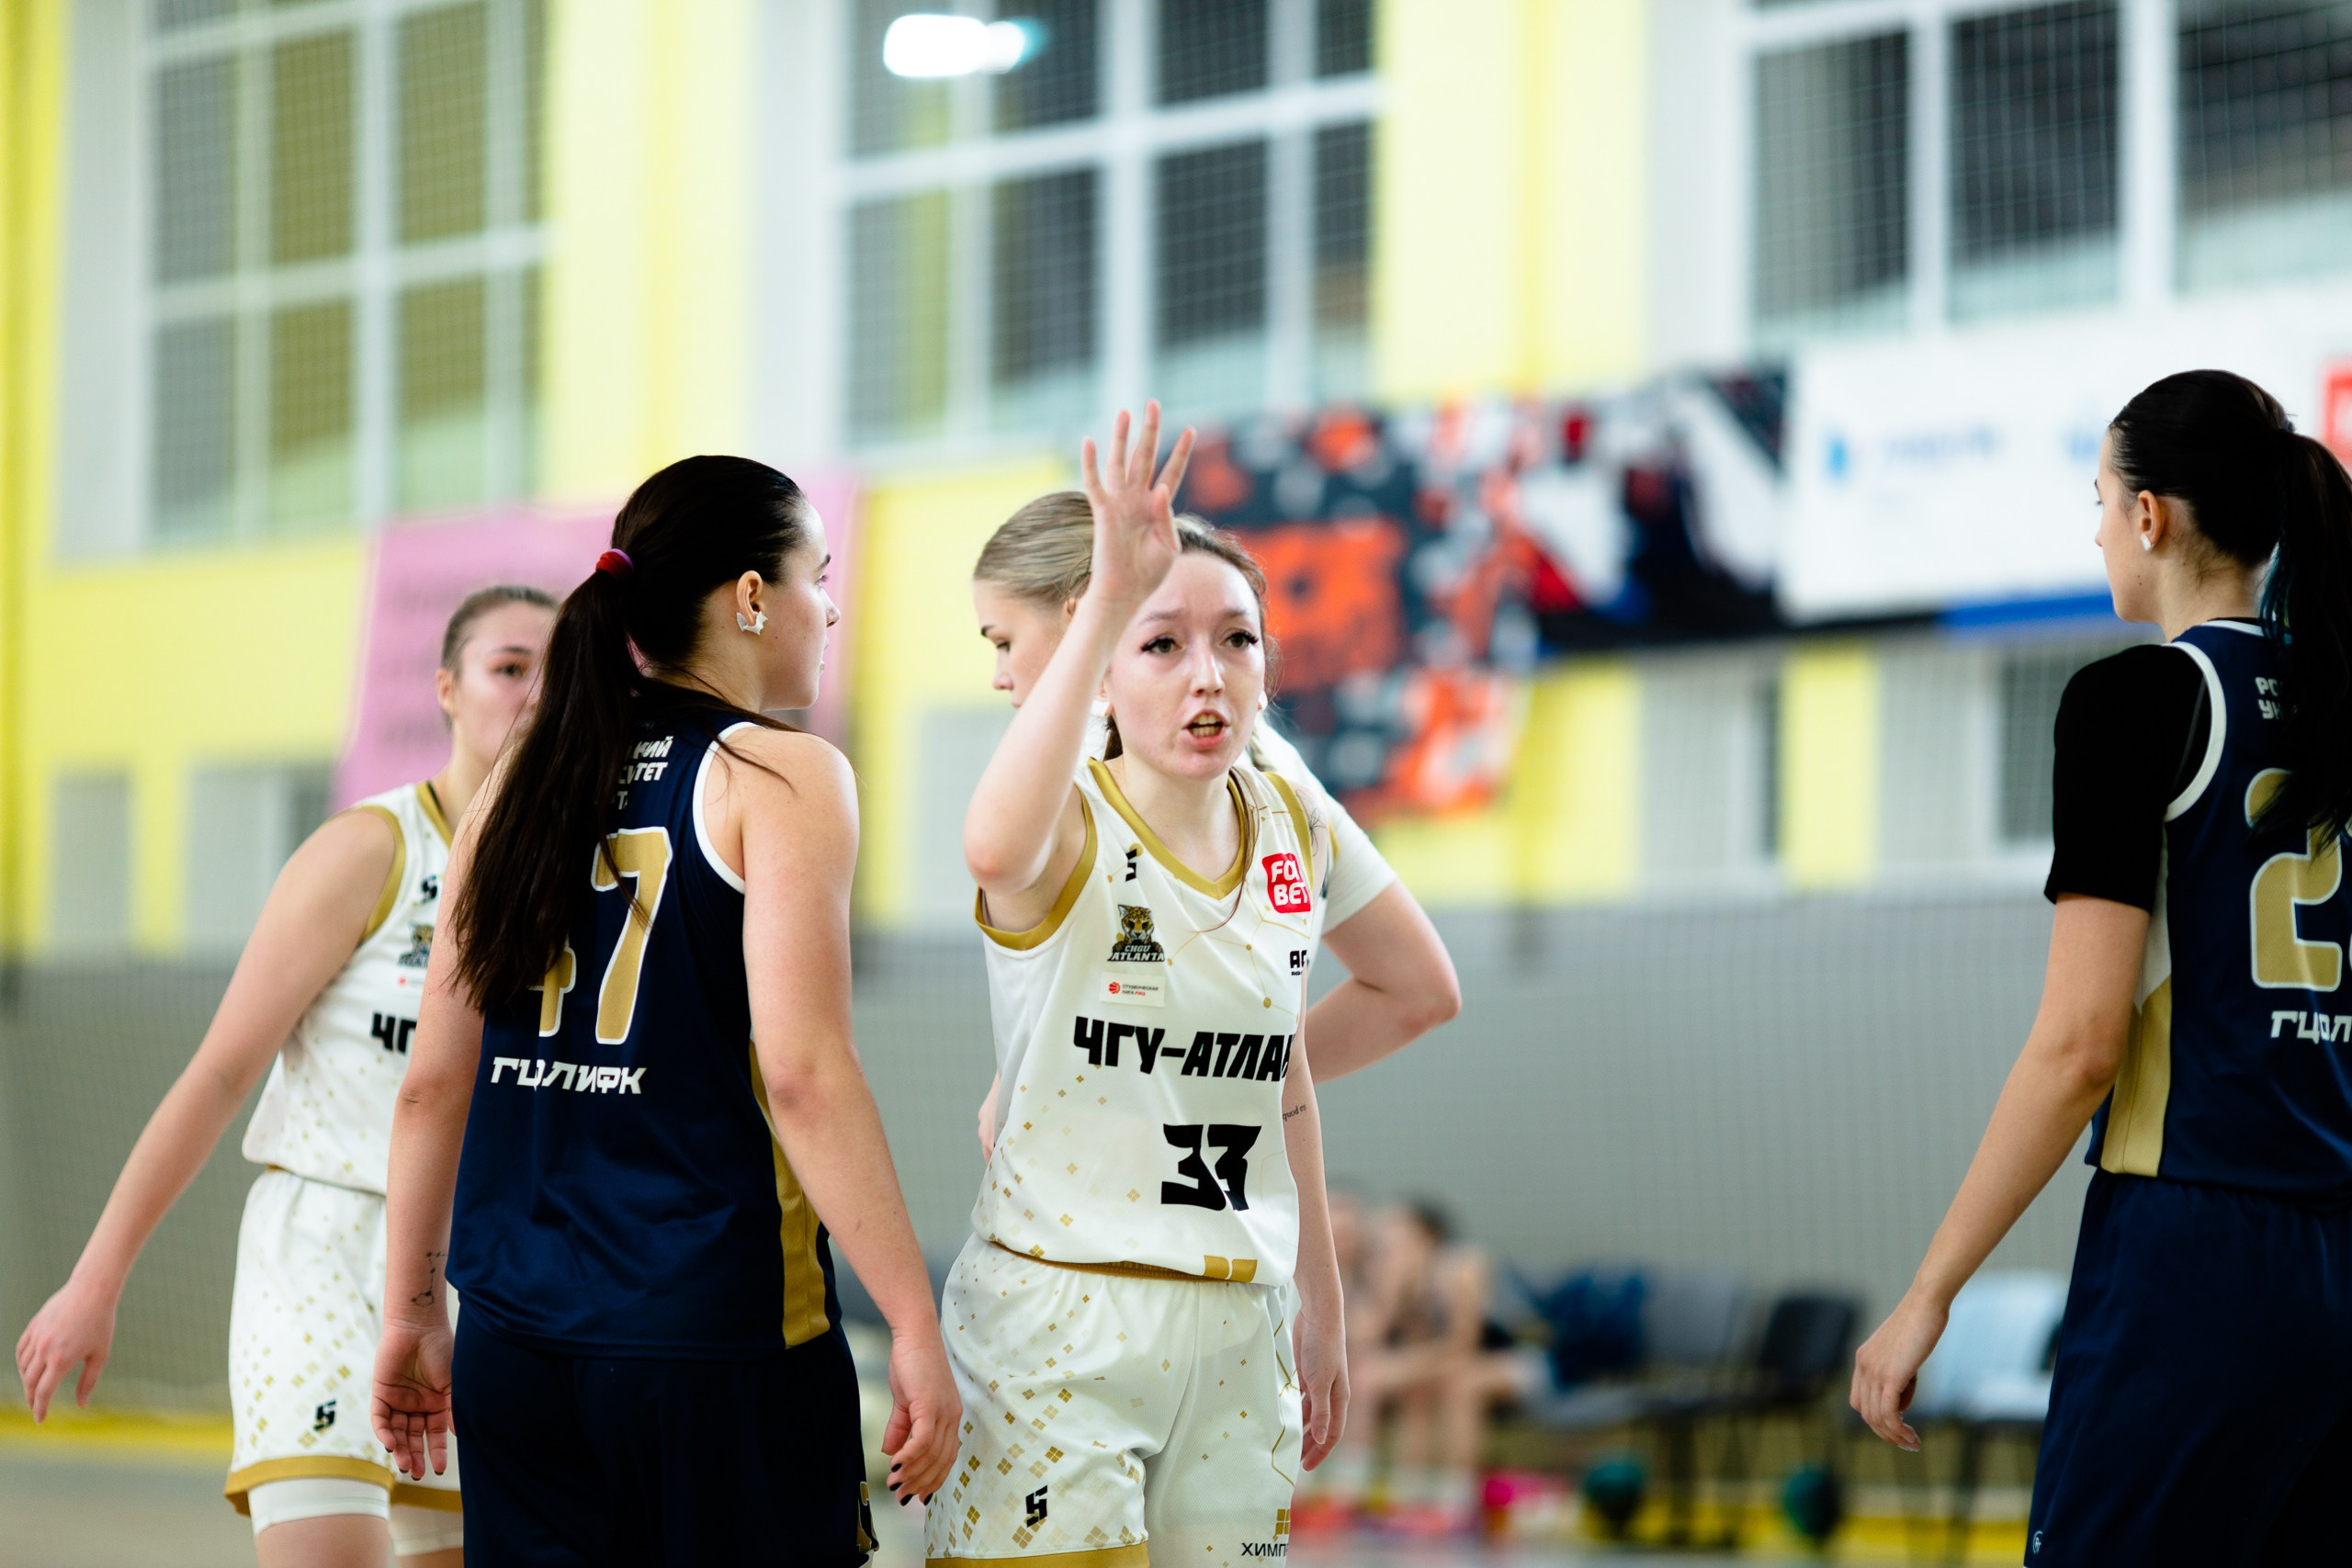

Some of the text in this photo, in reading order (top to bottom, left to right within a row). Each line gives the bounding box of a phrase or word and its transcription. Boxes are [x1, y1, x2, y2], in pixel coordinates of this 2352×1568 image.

[631, 736, 673, 759] КИЙ
[1111, 952, 1165, 961] ATLANTA
[1124, 944, 1151, 953] CHGU
[1073, 1016, 1295, 1082] ЧГУ-АТЛА
[1160, 1123, 1262, 1212] 33
[1241, 1542, 1288, 1557] ХИМП
